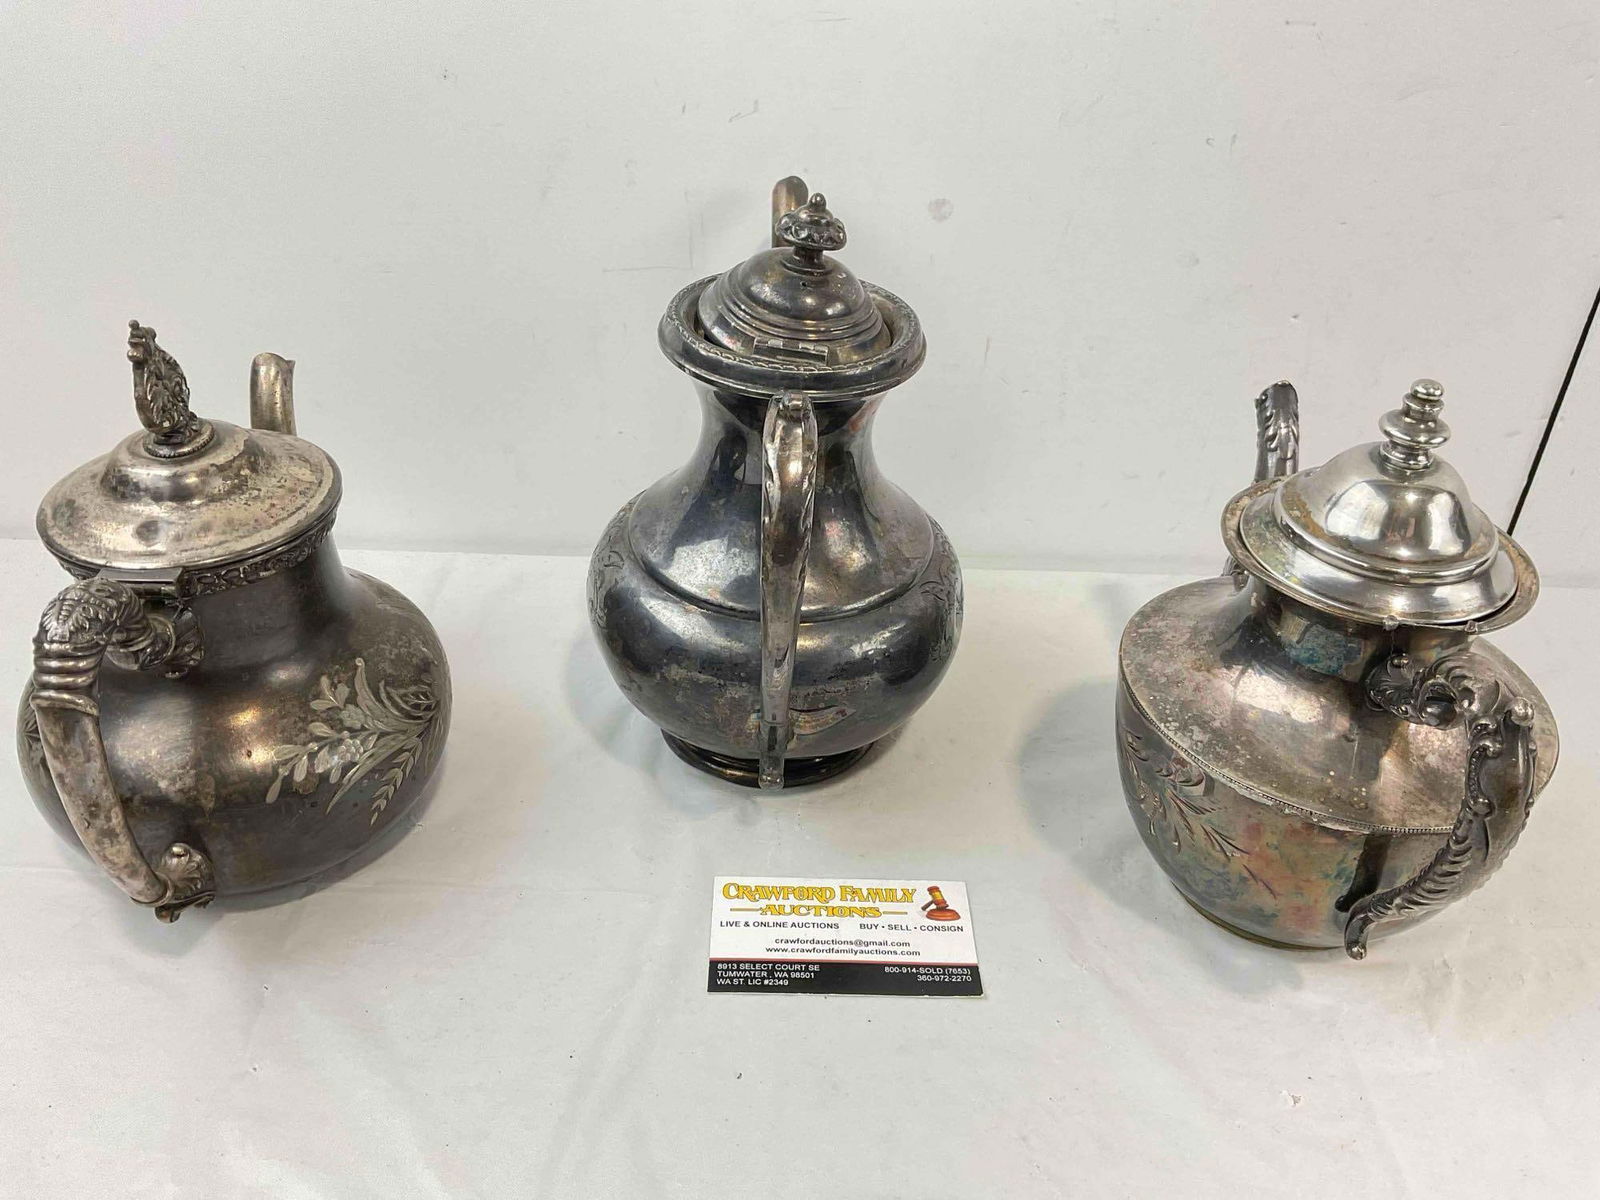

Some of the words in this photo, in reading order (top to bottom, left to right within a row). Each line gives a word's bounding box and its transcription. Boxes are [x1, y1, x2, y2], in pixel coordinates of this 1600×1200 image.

[722, 882, 836, 904] CRAWFORD
[839, 885, 917, 904] FAMILY
[760, 904, 883, 919] AUCTIONS
[720, 920, 741, 928] LIVE
[743, 920, 750, 928] &
[752, 921, 788, 929] ONLINE
[790, 921, 840, 930] AUCTIONS
[887, 924, 912, 932] SELL
[774, 937, 911, 948] crawfordauctions@gmail.com
[765, 946, 921, 957] www.crawfordfamilyauctions.com
[790, 971, 815, 979] 98501
